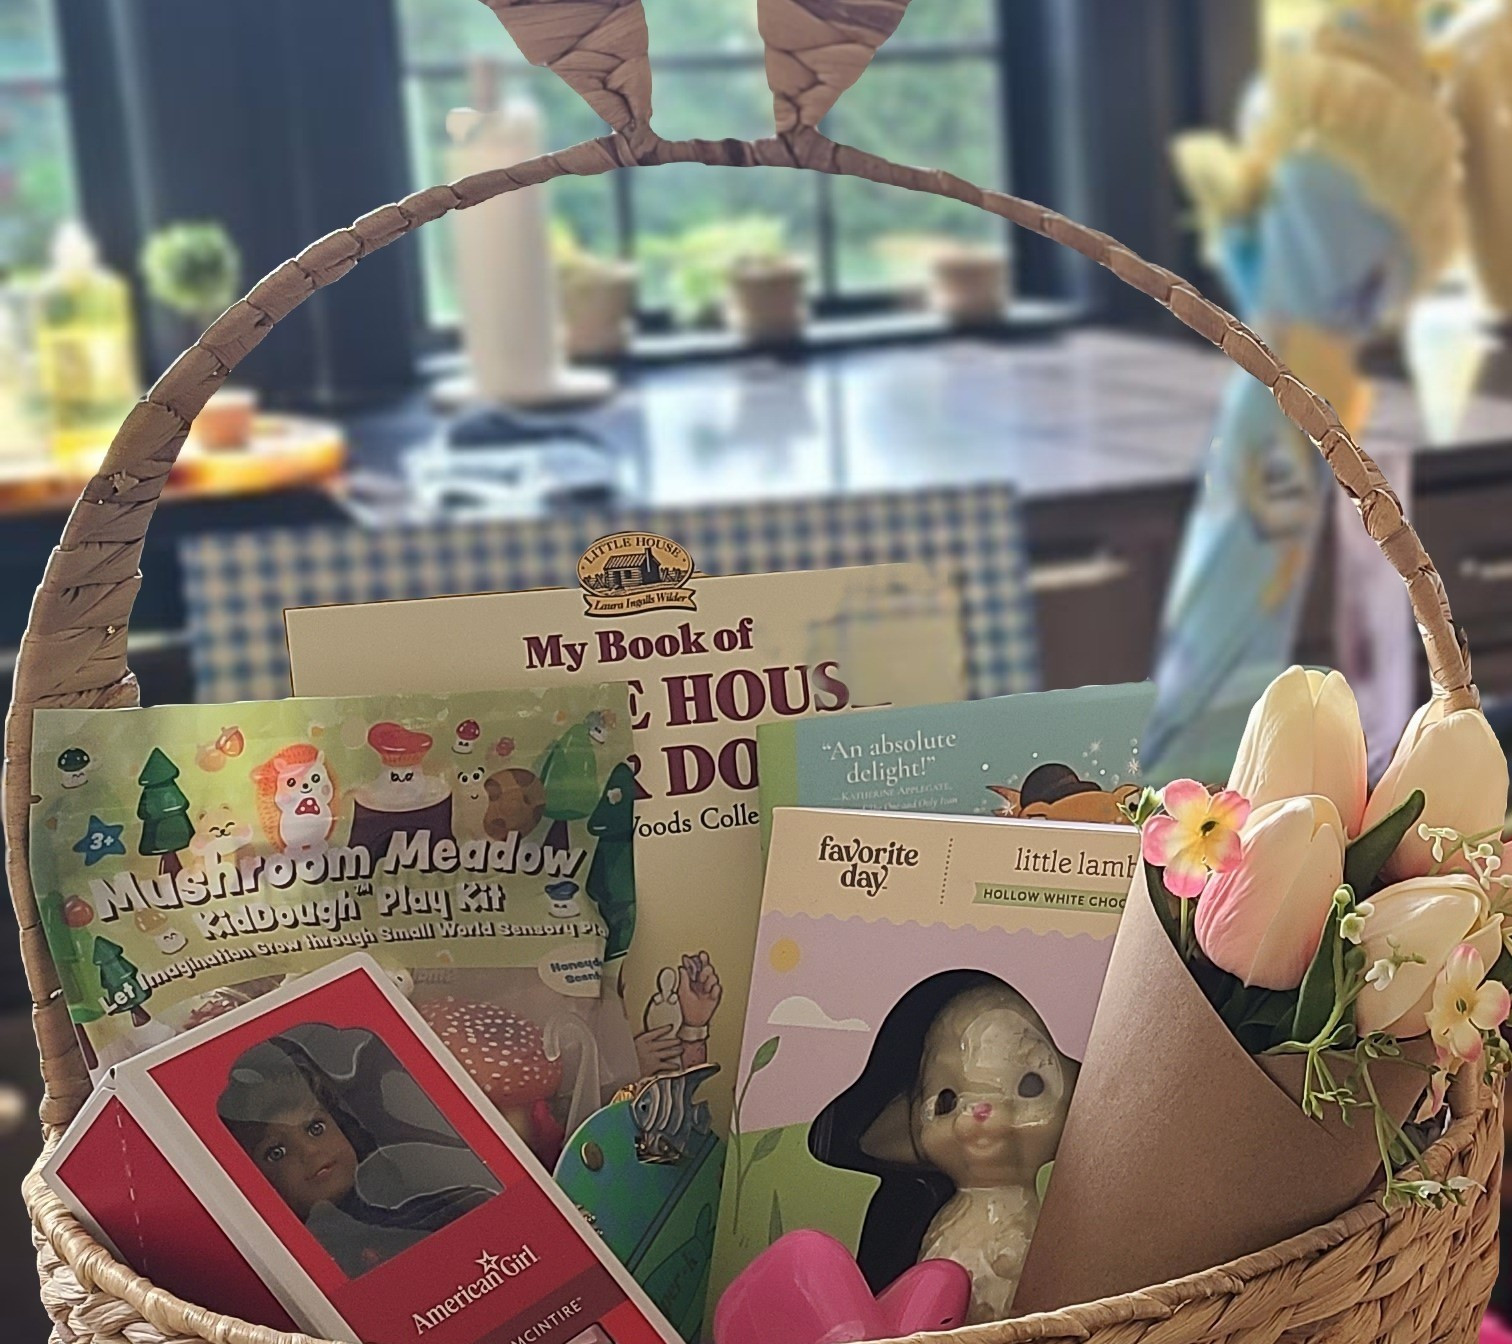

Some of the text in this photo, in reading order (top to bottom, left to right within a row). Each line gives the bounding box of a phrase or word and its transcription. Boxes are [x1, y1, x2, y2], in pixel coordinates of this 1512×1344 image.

[584, 537, 681, 564] LITTLE HOUSE
[594, 592, 687, 610] Laura Ingalls Wilder
[523, 618, 754, 672] My Book of
[662, 661, 892, 727] HOUS
[870, 730, 957, 756] absolute
[633, 809, 692, 838] oods
[89, 833, 114, 850] 3+
[818, 835, 919, 866] favorite
[89, 829, 586, 922] Mushroom Meadow
[1014, 848, 1072, 874] little
[840, 864, 888, 897] day
[377, 885, 452, 921] Play
[456, 881, 505, 914] Kit
[983, 888, 1040, 903] HOLLOW
[1042, 893, 1085, 906] WHITE
[98, 982, 136, 1016] Let
[137, 942, 257, 992] Imagination
[257, 939, 302, 955] Grow
[380, 922, 435, 942] Small
[439, 920, 496, 938] World
[500, 922, 579, 939] Sensory
[411, 1244, 539, 1336] American Girl
